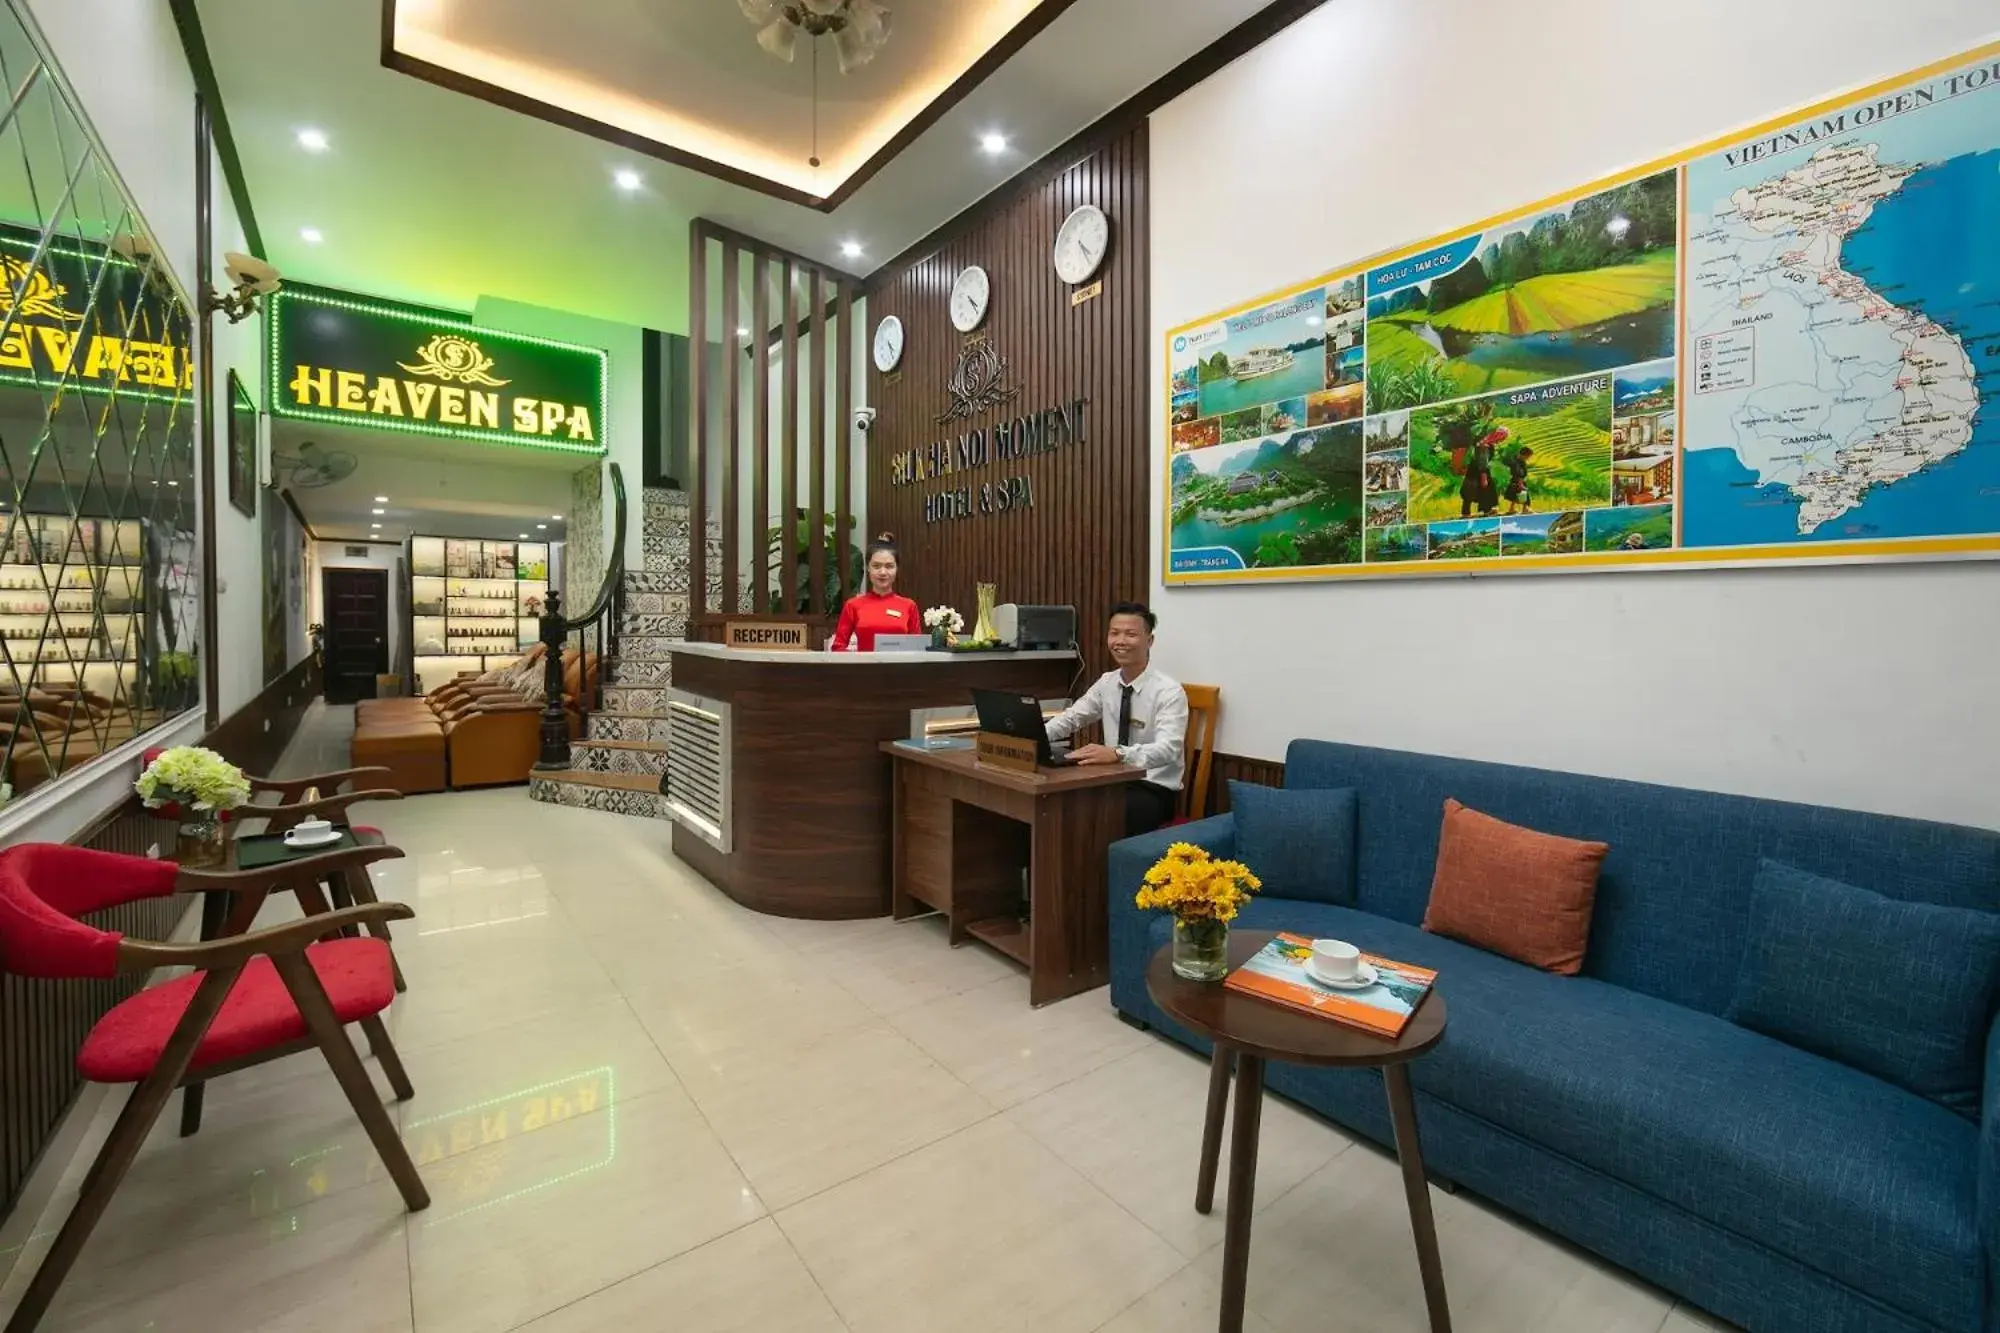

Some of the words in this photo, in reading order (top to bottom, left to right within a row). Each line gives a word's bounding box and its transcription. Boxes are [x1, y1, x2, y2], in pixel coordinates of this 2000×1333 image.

[1724, 117, 1845, 166] VIETNAM
[1854, 85, 1934, 125] OPEN
[1782, 269, 1807, 284] LAOS
[1731, 312, 1773, 327] THAILAND
[290, 365, 499, 429] HEAVEN
[512, 397, 595, 441] SPA
[1510, 391, 1537, 405] SAPA
[1542, 378, 1607, 400] ADVENTURE
[928, 438, 953, 478] HA
[957, 428, 990, 473] NOI
[996, 398, 1089, 464] MOMENT
[1780, 432, 1833, 446] CAMBODIA
[925, 486, 973, 523] HOTEL
[980, 482, 993, 513] &
[998, 474, 1034, 513] SPA
[734, 628, 801, 644] RECEPTION
